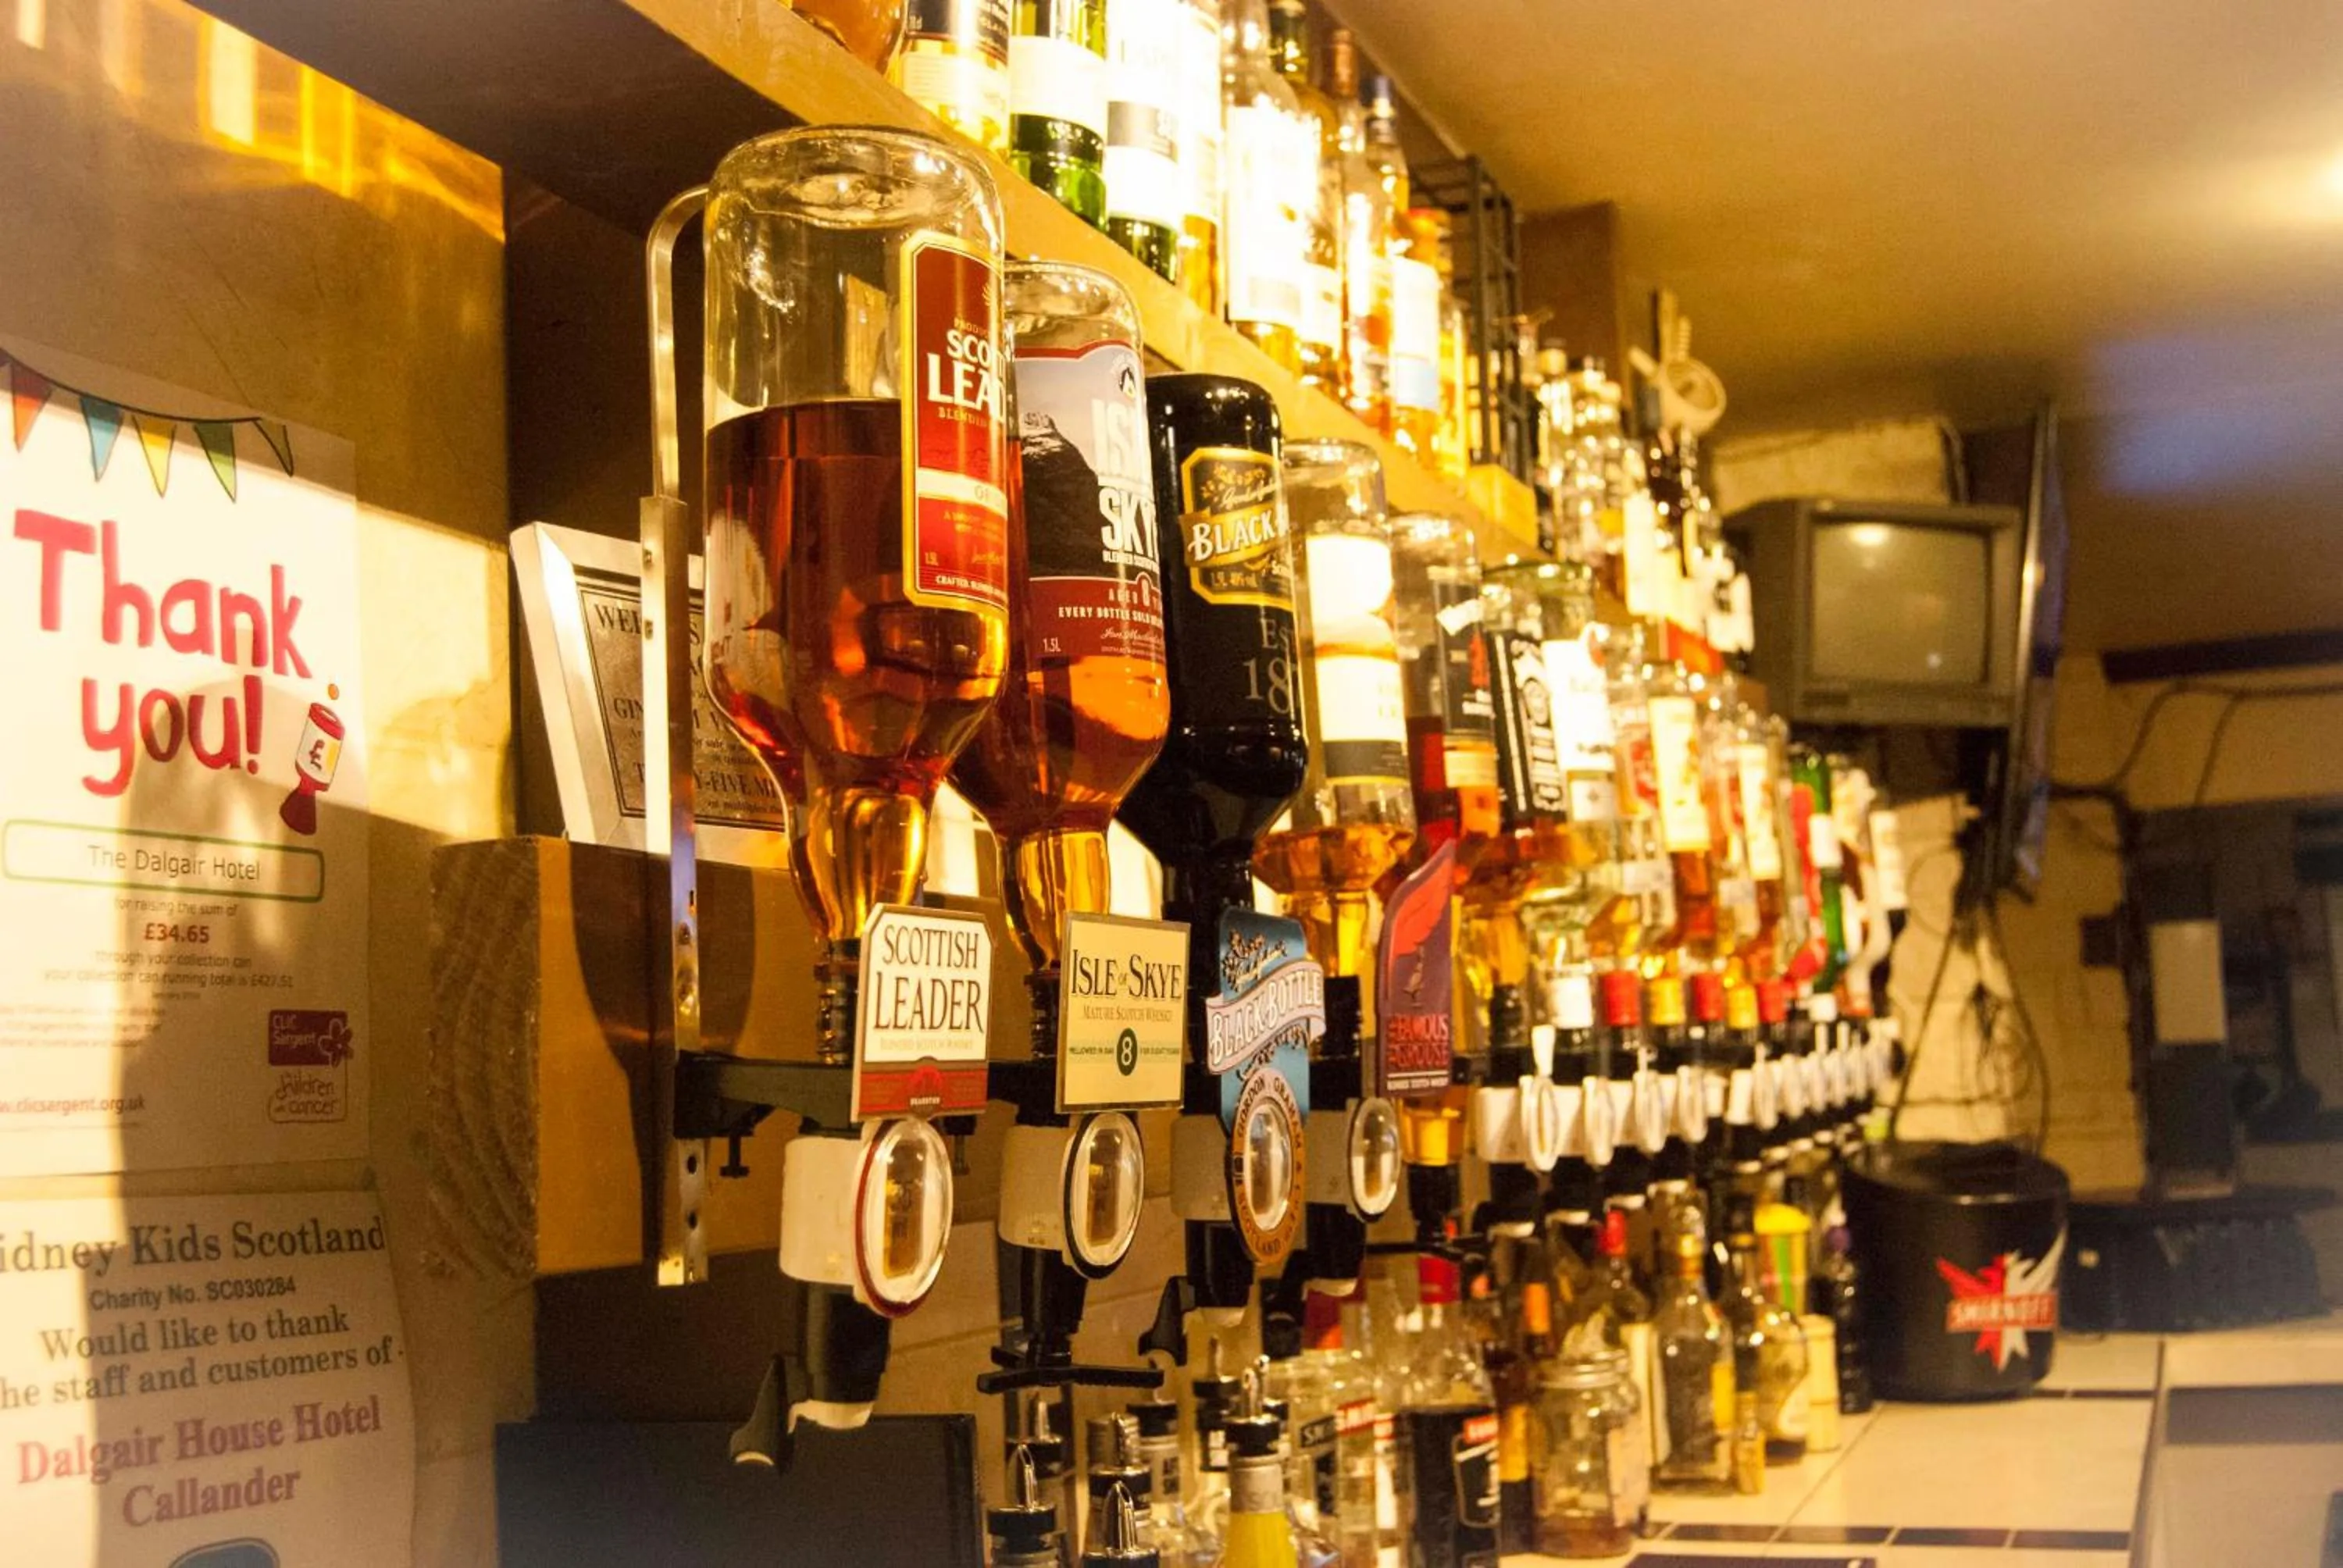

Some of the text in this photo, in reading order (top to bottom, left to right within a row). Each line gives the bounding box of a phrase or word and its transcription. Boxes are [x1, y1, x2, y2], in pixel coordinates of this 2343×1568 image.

[1188, 508, 1276, 562] BLACK
[14, 508, 313, 679] Thank
[1243, 657, 1291, 714] 18
[81, 674, 263, 798] you!
[87, 844, 261, 881] The Dalgair Hotel
[144, 922, 211, 943] £34.65
[883, 925, 979, 969] SCOTTISH
[874, 971, 984, 1034] LEADER
[1071, 950, 1117, 996] ISLE
[1129, 953, 1182, 999] SKYE
[1210, 969, 1322, 1066] BLACK BOTTLE
[1121, 1036, 1132, 1066] 8
[0, 1216, 387, 1276] idney Kids Scotland
[91, 1275, 296, 1311] Charity No. SC030284
[40, 1305, 351, 1362] Would like to thank
[0, 1335, 394, 1409] he staff and customers of
[17, 1395, 381, 1484] Dalgair House Hotel
[122, 1467, 301, 1527] Callander
